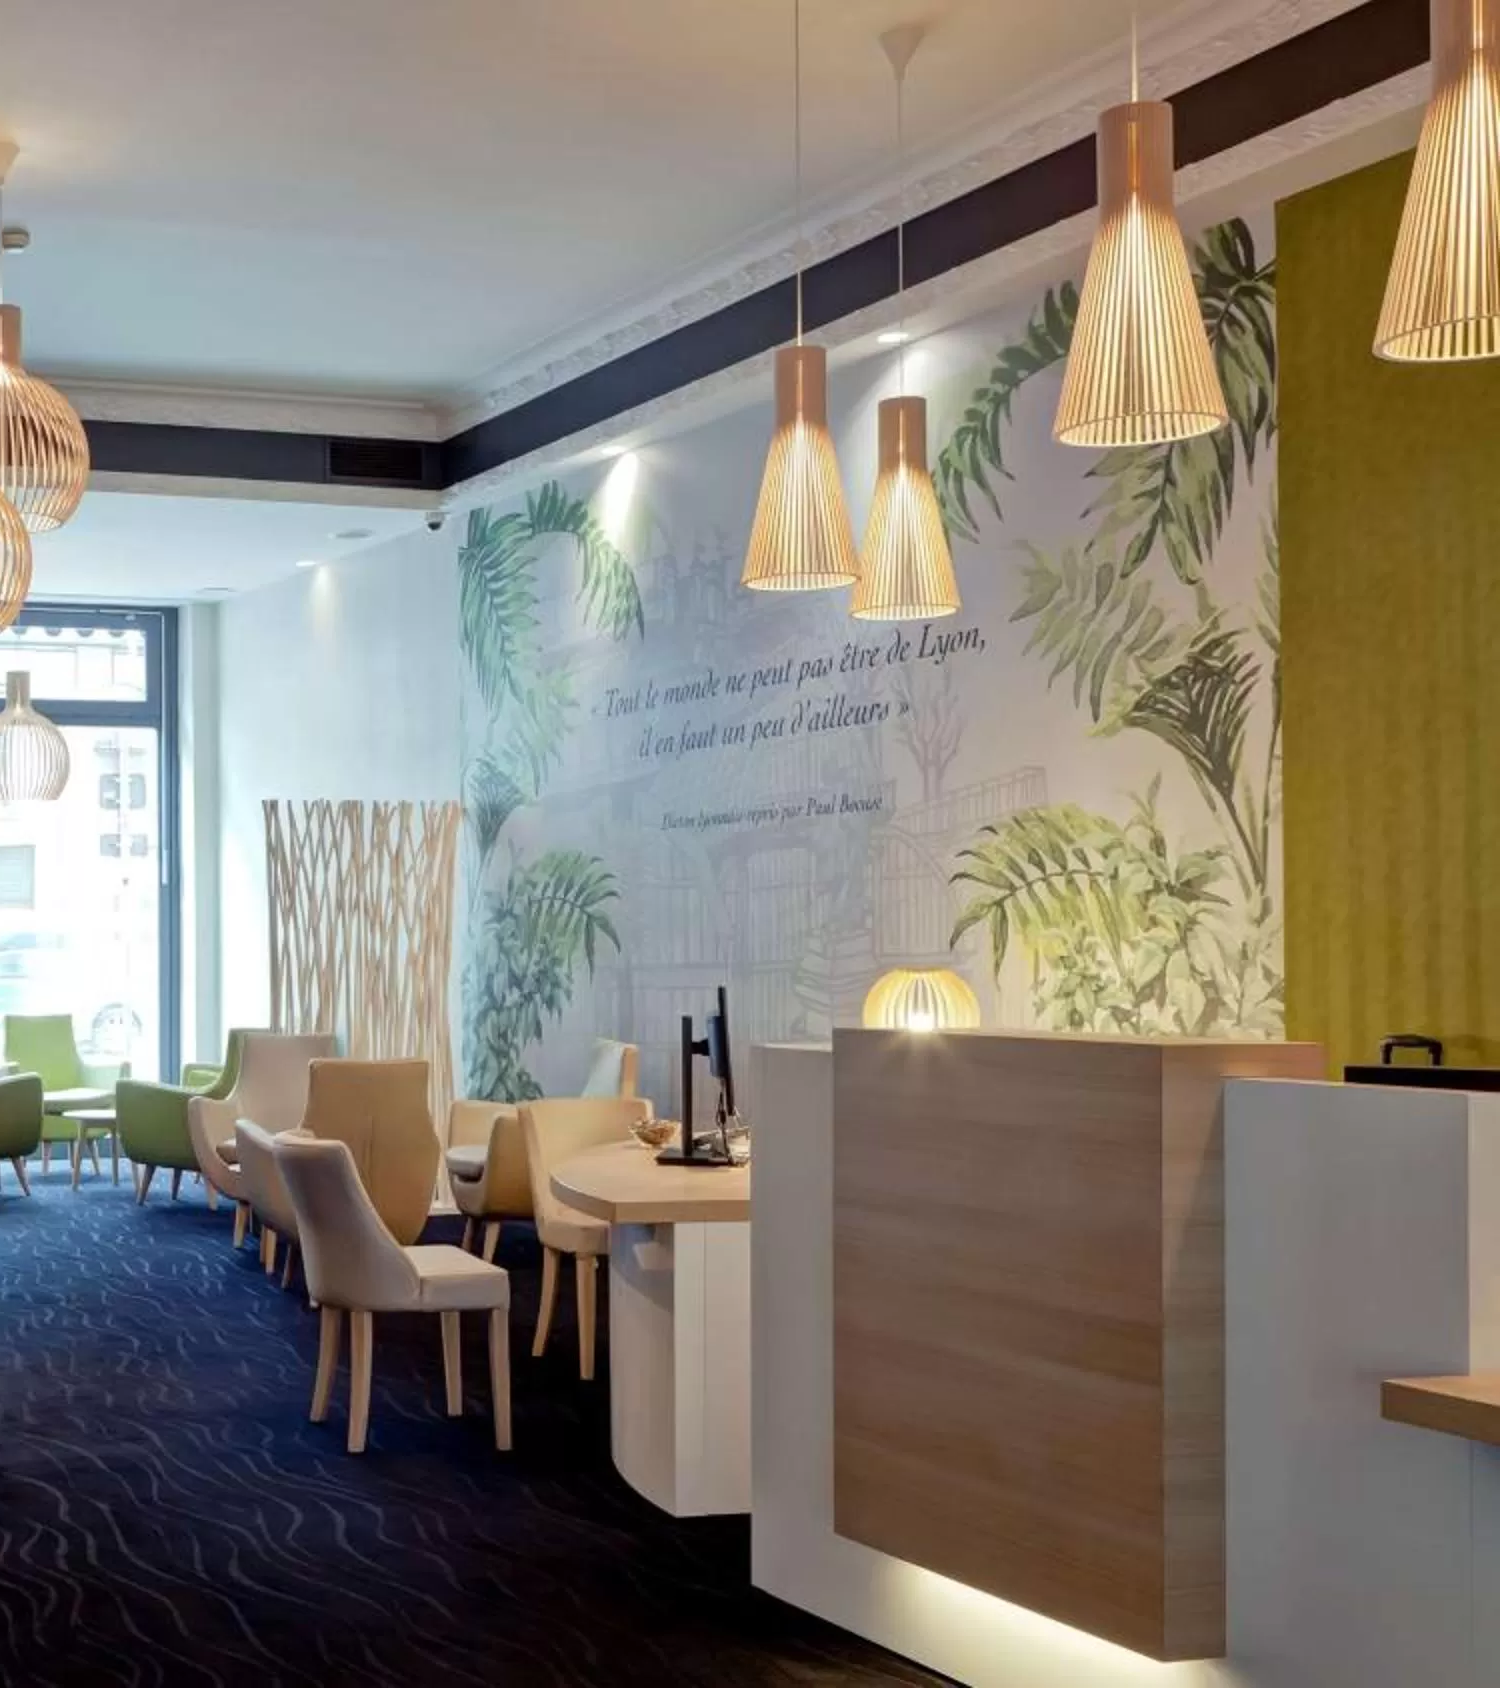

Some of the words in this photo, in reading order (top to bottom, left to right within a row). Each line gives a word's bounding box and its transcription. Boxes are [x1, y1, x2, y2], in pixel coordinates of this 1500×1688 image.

[604, 687, 641, 717] Tout
[644, 678, 660, 710] le
[663, 667, 722, 704] monde
[725, 673, 747, 694] ne
[749, 658, 793, 700] peut
[796, 657, 834, 691] pas
[838, 641, 881, 673] être
[886, 628, 912, 665] de
[916, 623, 986, 665] Lyon,
[675, 719, 718, 761] faut
[721, 723, 746, 746] un
[748, 717, 787, 751] peu
